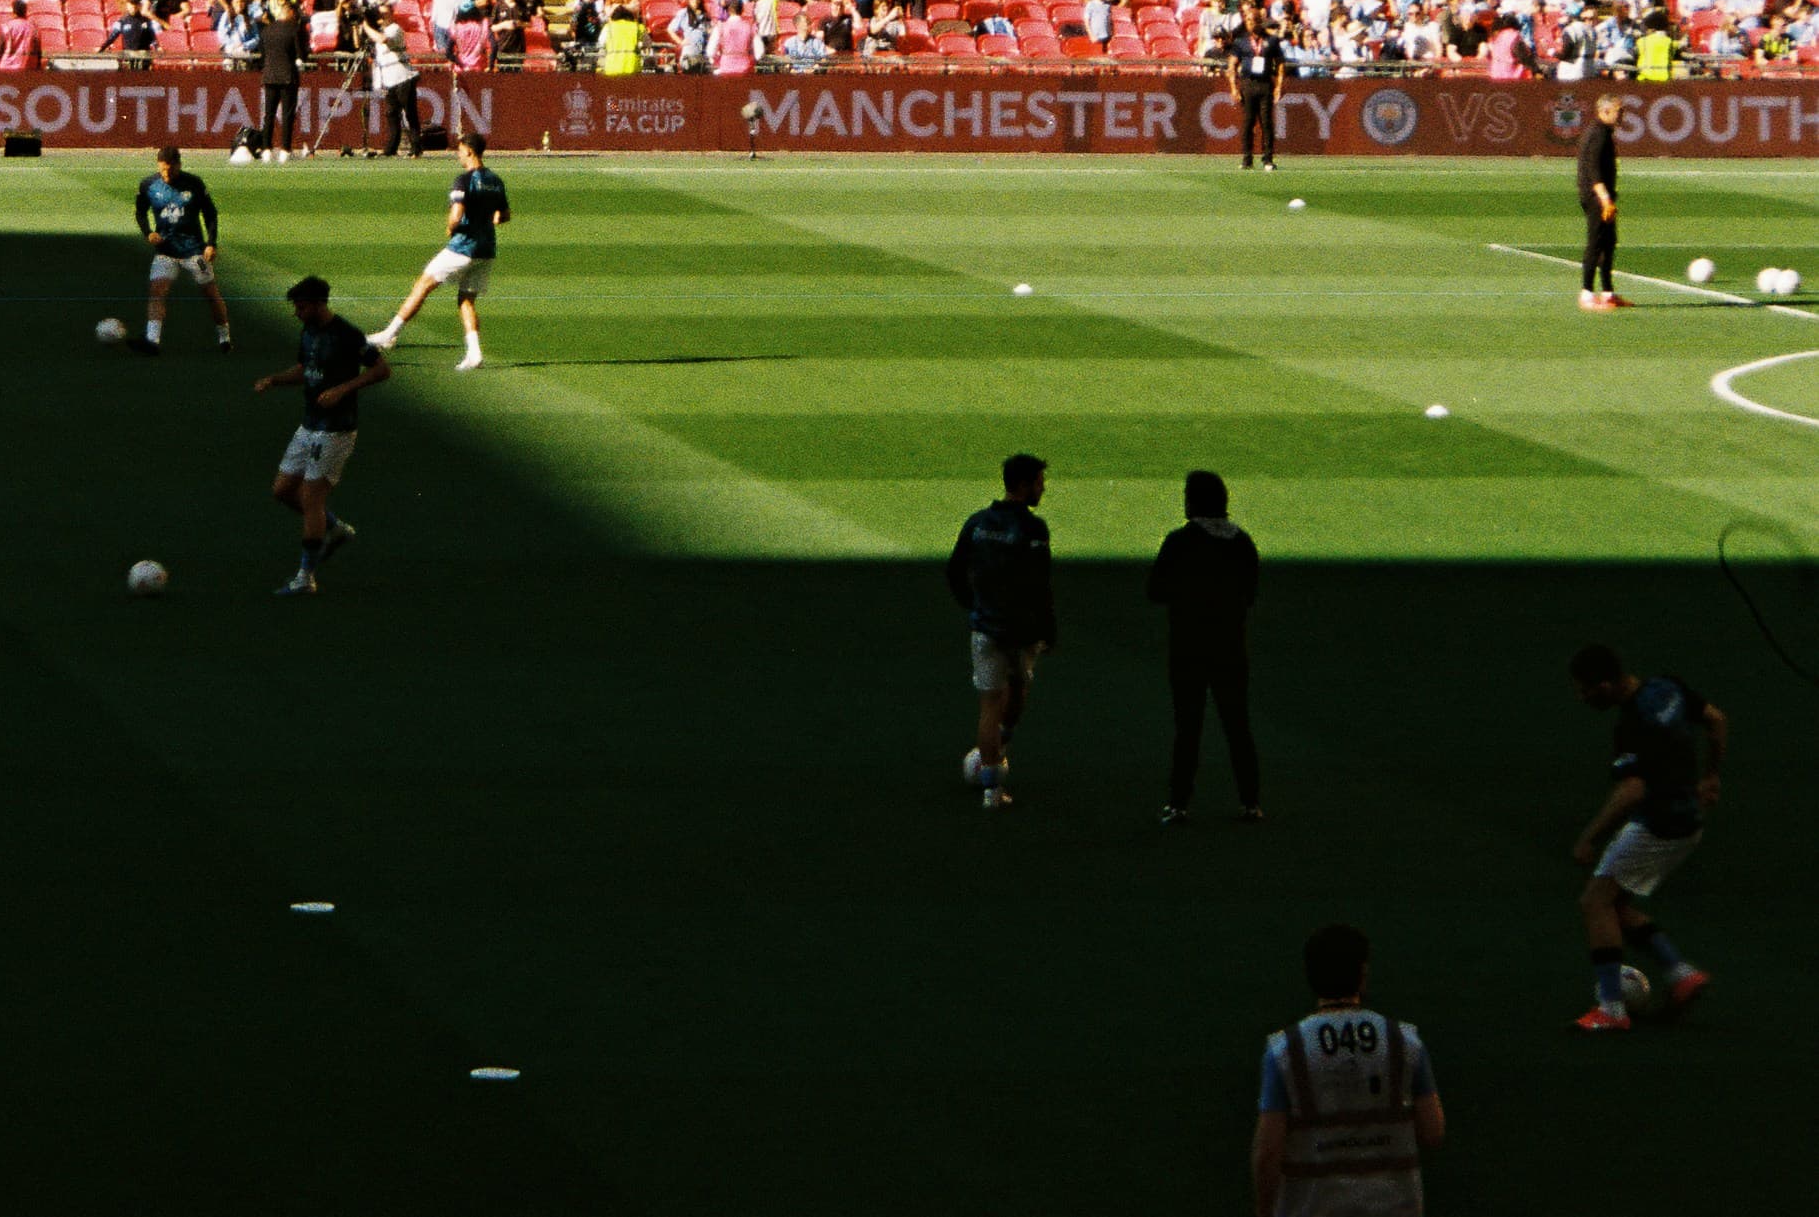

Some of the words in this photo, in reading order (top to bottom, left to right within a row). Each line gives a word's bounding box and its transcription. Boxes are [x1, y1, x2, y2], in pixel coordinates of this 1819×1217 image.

[605, 94, 685, 113] Emirates
[748, 89, 1177, 138] MANCHESTER
[1438, 91, 1518, 143] VS
[605, 114, 633, 133] FA
[637, 114, 686, 134] CUP
[1319, 1020, 1377, 1057] 049
